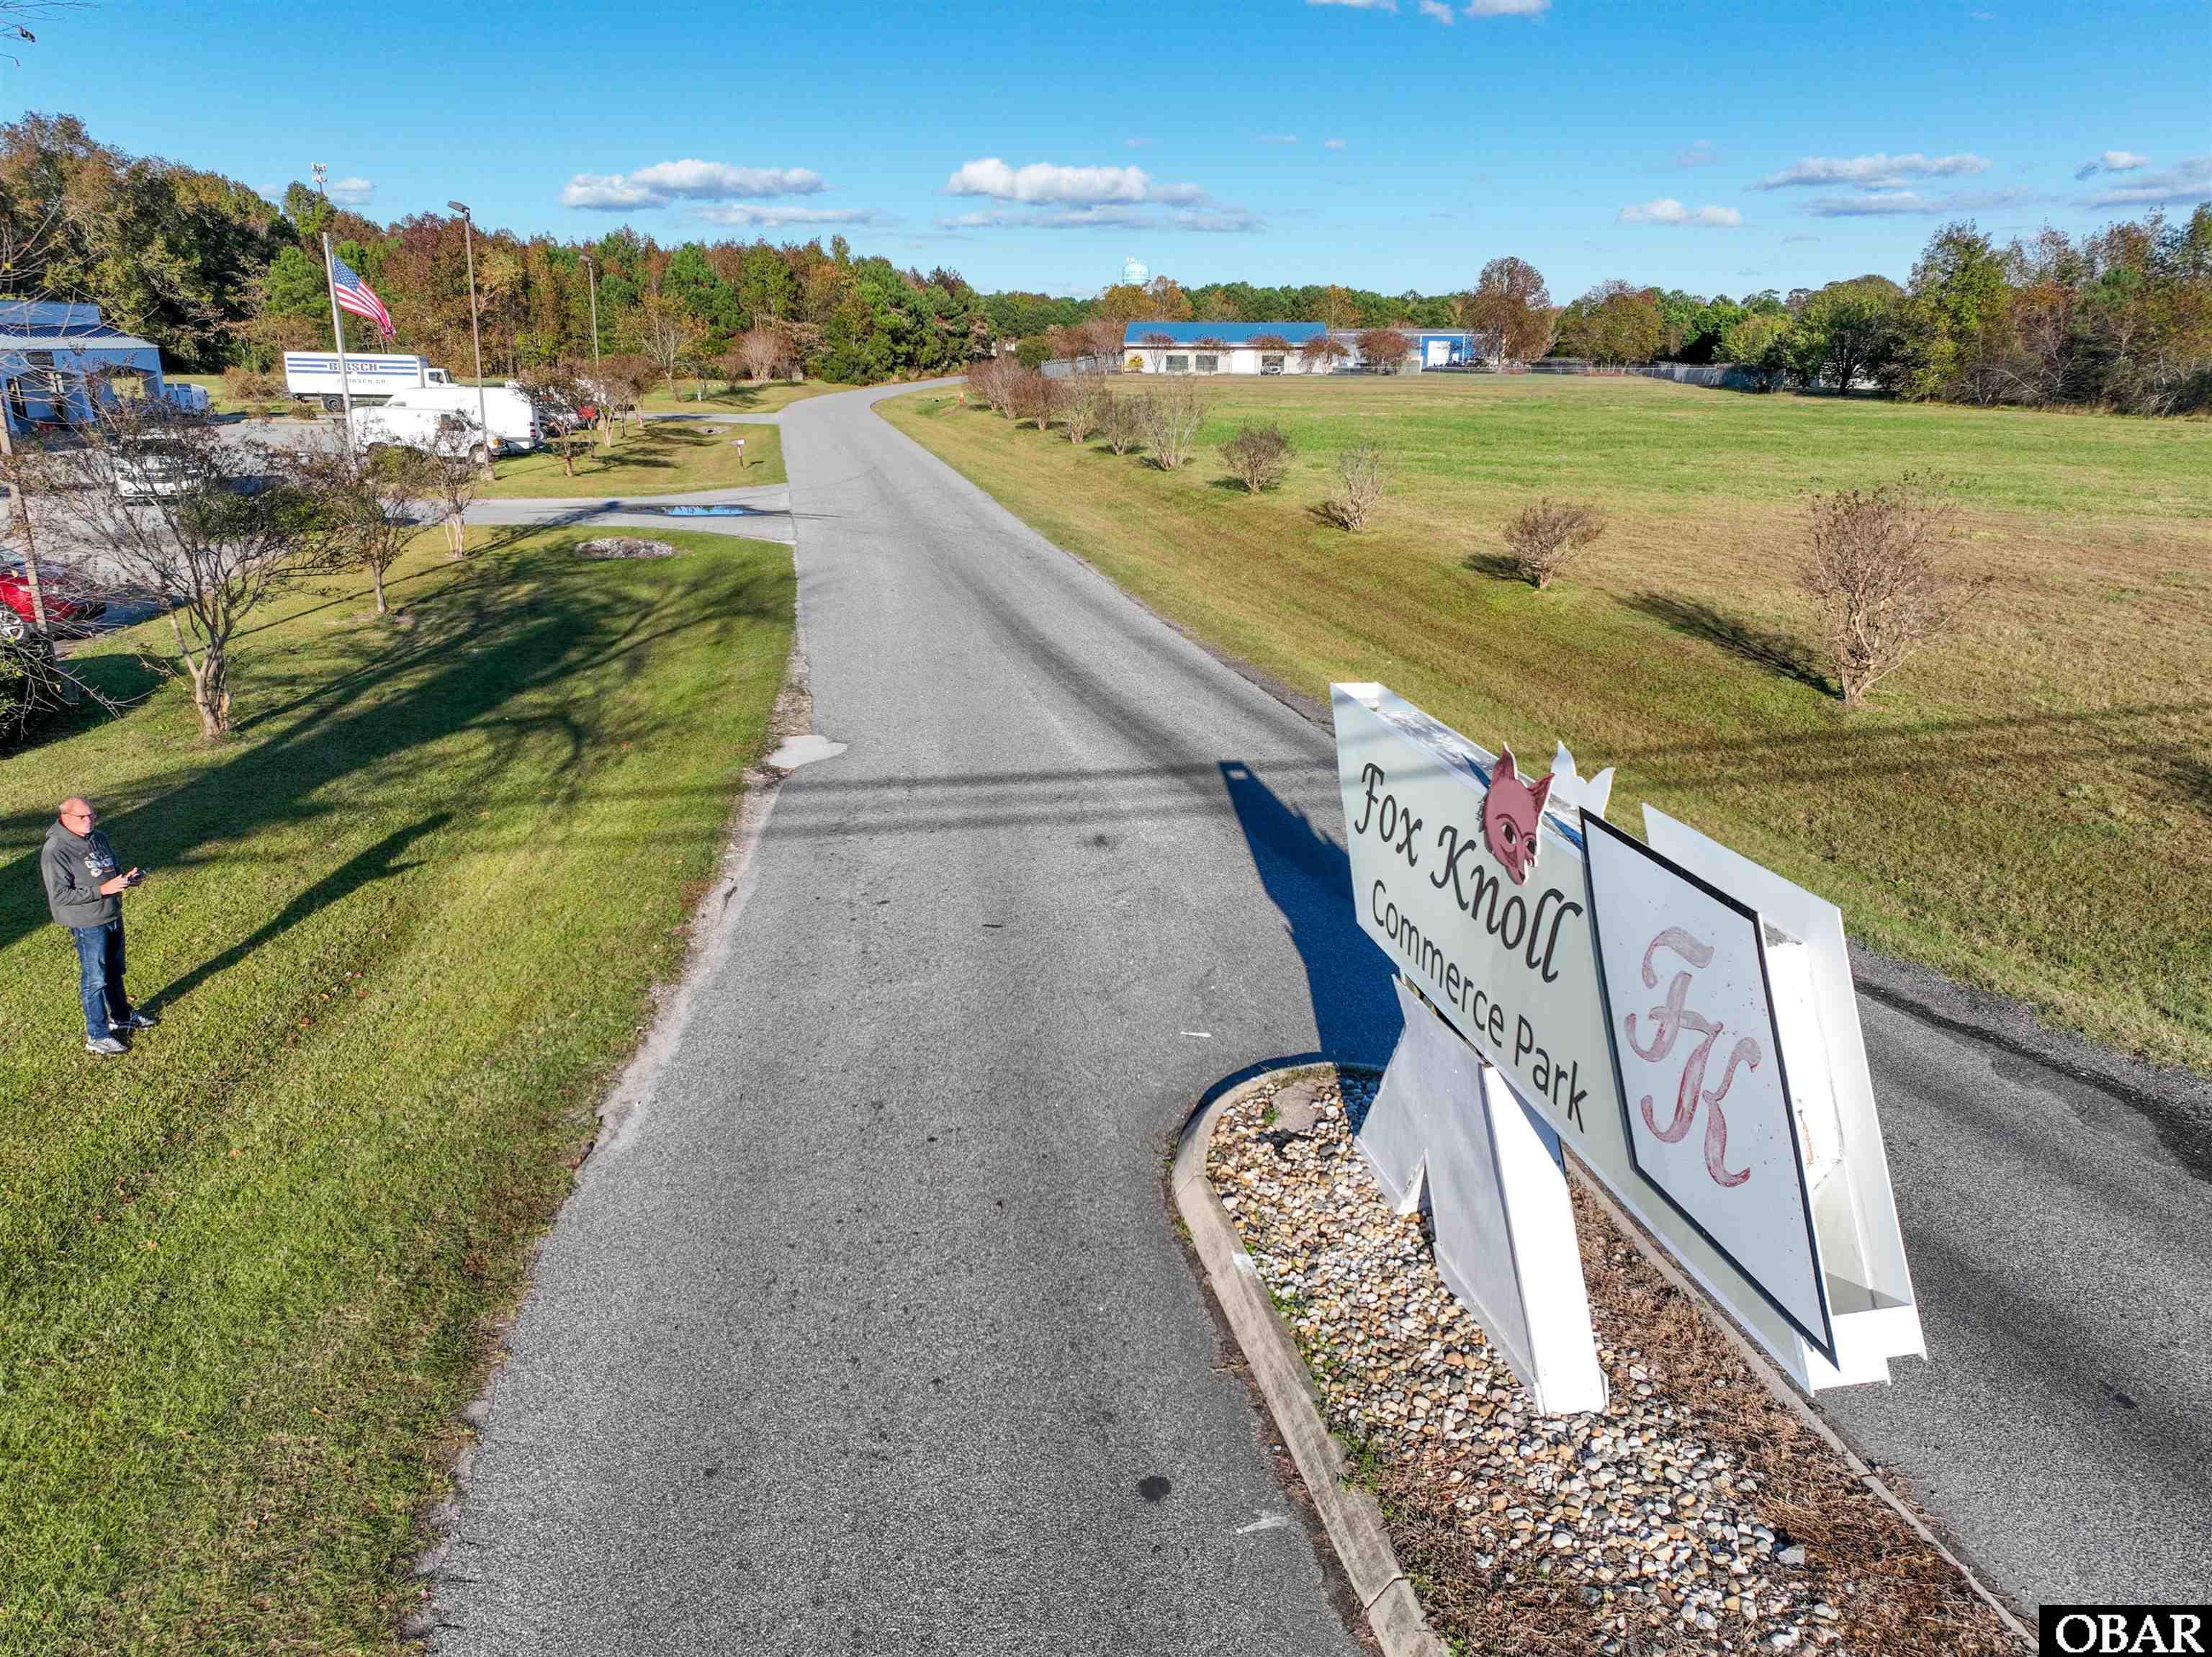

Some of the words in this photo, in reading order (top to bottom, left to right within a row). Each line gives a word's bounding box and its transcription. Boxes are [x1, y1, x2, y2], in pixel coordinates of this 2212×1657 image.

[329, 362, 378, 371] BRSCH
[1354, 762, 1423, 867] Fox
[1429, 825, 1583, 984] Knoll
[1372, 879, 1504, 1048] Commerce
[1514, 1013, 1588, 1134] Park
